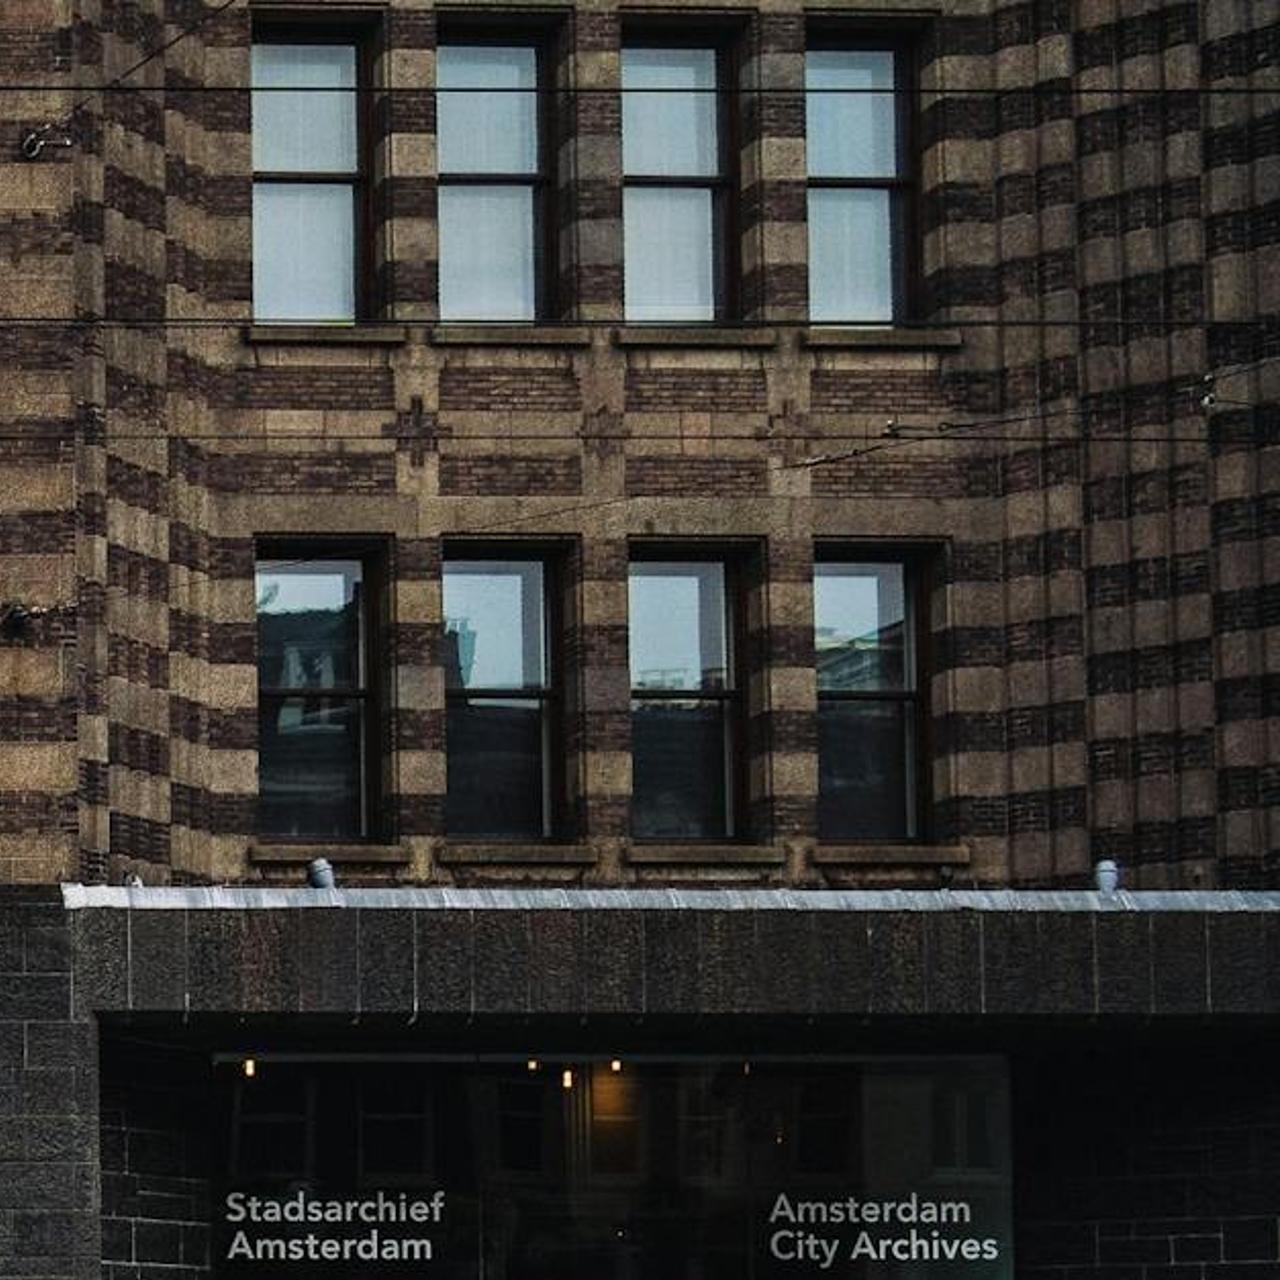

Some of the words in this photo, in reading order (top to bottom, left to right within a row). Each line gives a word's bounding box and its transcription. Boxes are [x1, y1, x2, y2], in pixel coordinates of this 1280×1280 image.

[225, 1190, 446, 1222] Stadsarchief
[769, 1191, 973, 1223] Amsterdam
[226, 1229, 434, 1261] Amsterdam
[770, 1230, 841, 1270] City
[850, 1228, 1001, 1262] Archives
